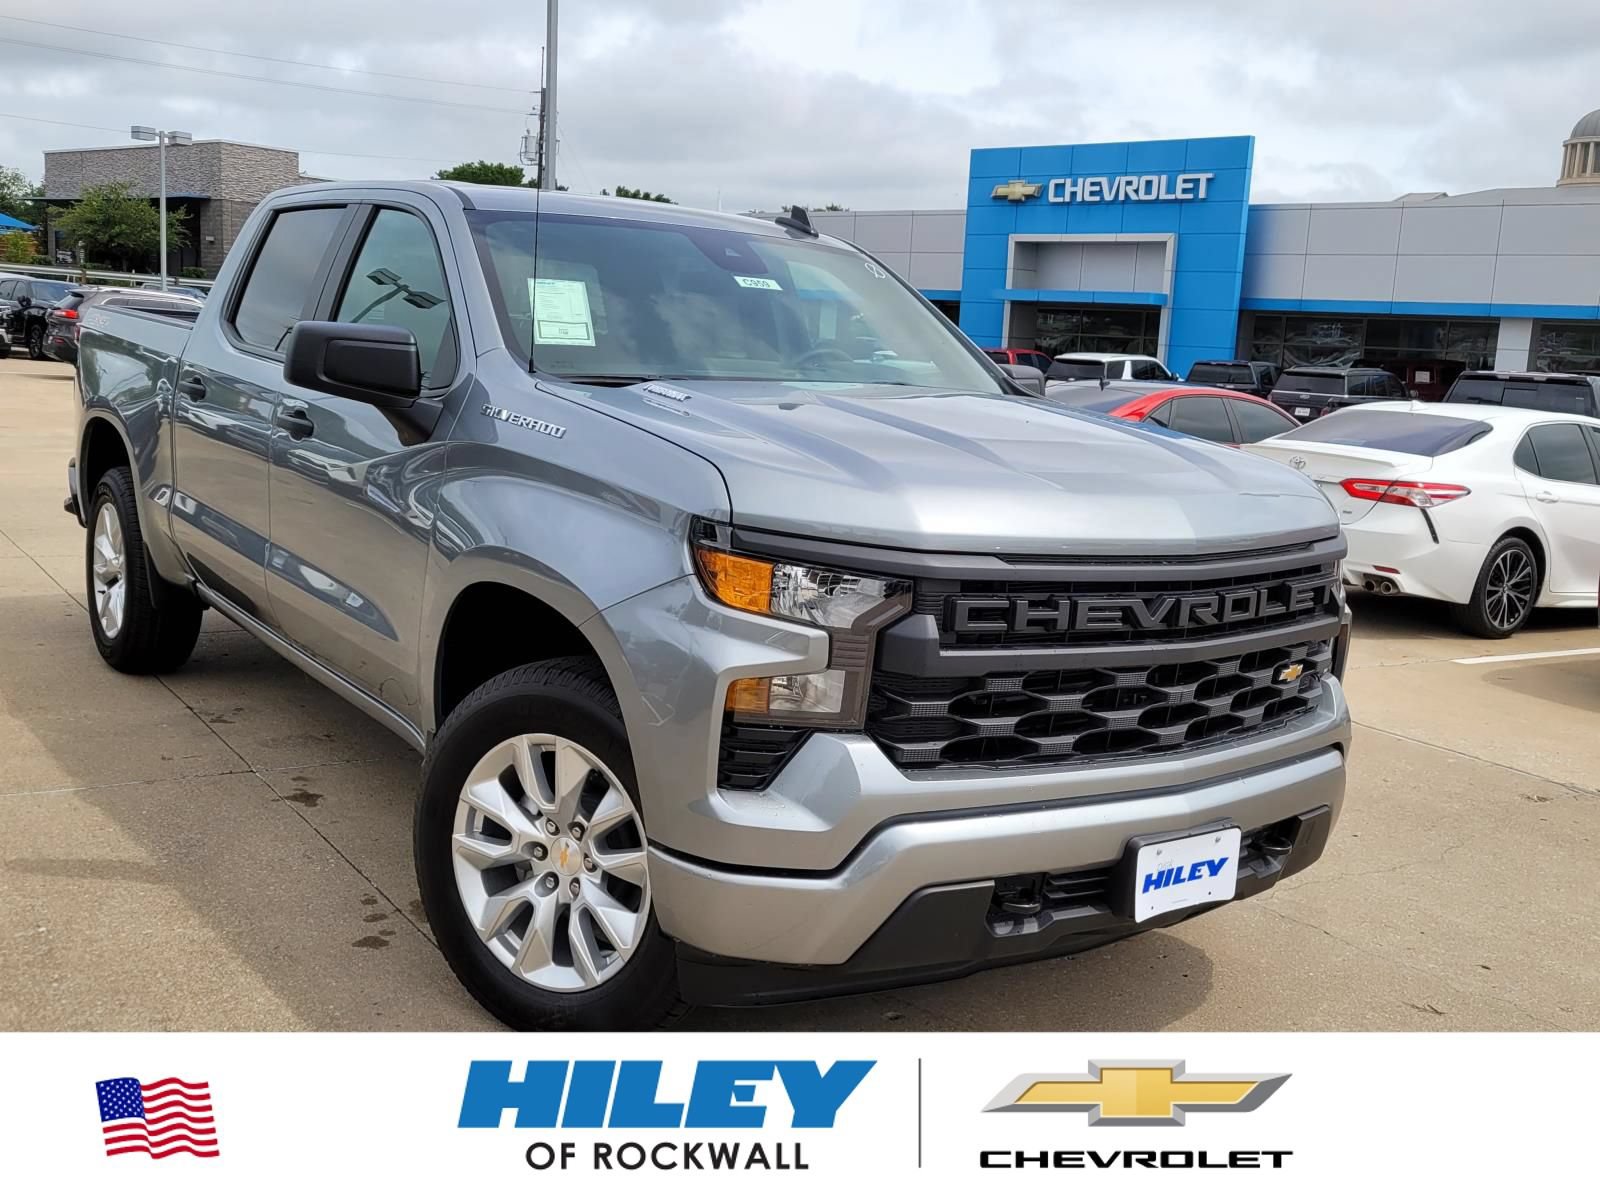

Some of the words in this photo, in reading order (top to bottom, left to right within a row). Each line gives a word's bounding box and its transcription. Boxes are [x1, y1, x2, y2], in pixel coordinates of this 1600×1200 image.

[1049, 173, 1214, 203] CHEVROLET
[481, 404, 567, 439] SILVERADO
[953, 577, 1338, 631] CHEVROLET
[1142, 857, 1229, 894] HILEY
